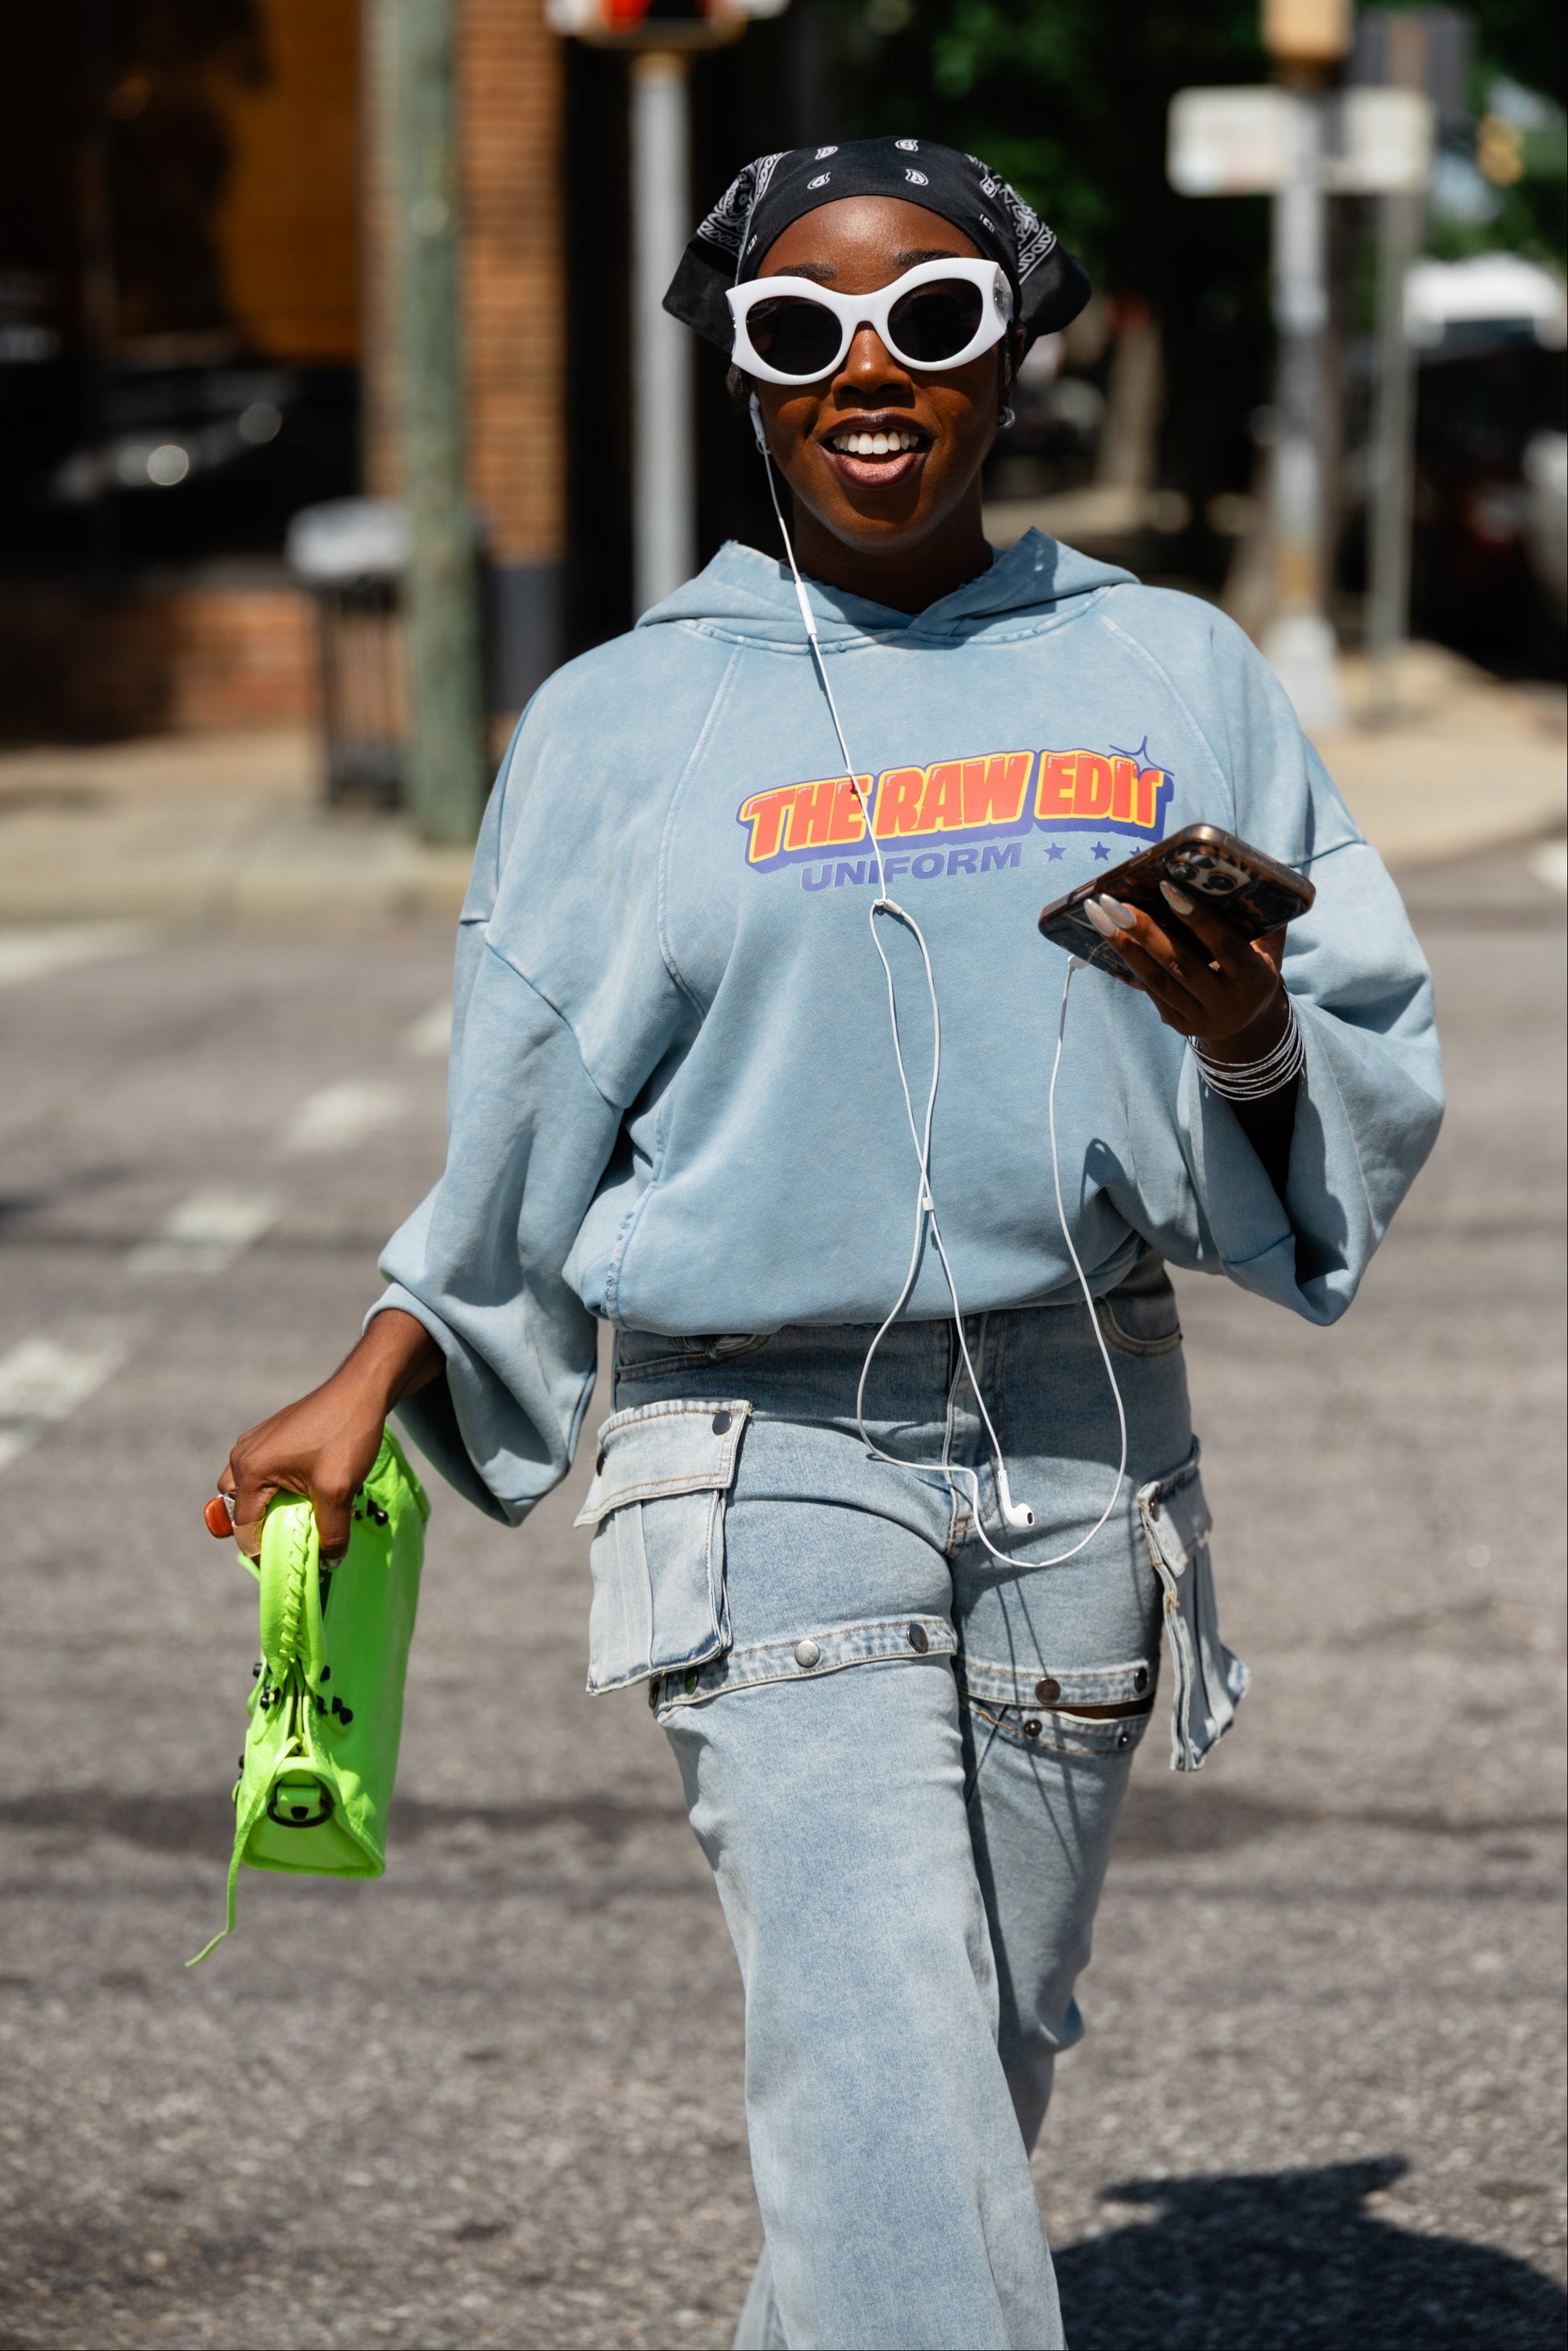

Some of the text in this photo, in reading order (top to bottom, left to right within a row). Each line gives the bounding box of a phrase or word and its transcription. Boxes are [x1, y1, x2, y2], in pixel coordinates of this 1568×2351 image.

[739, 748, 1165, 864] THE RAW EDIT
[801, 842, 1022, 892] UNIFORM
